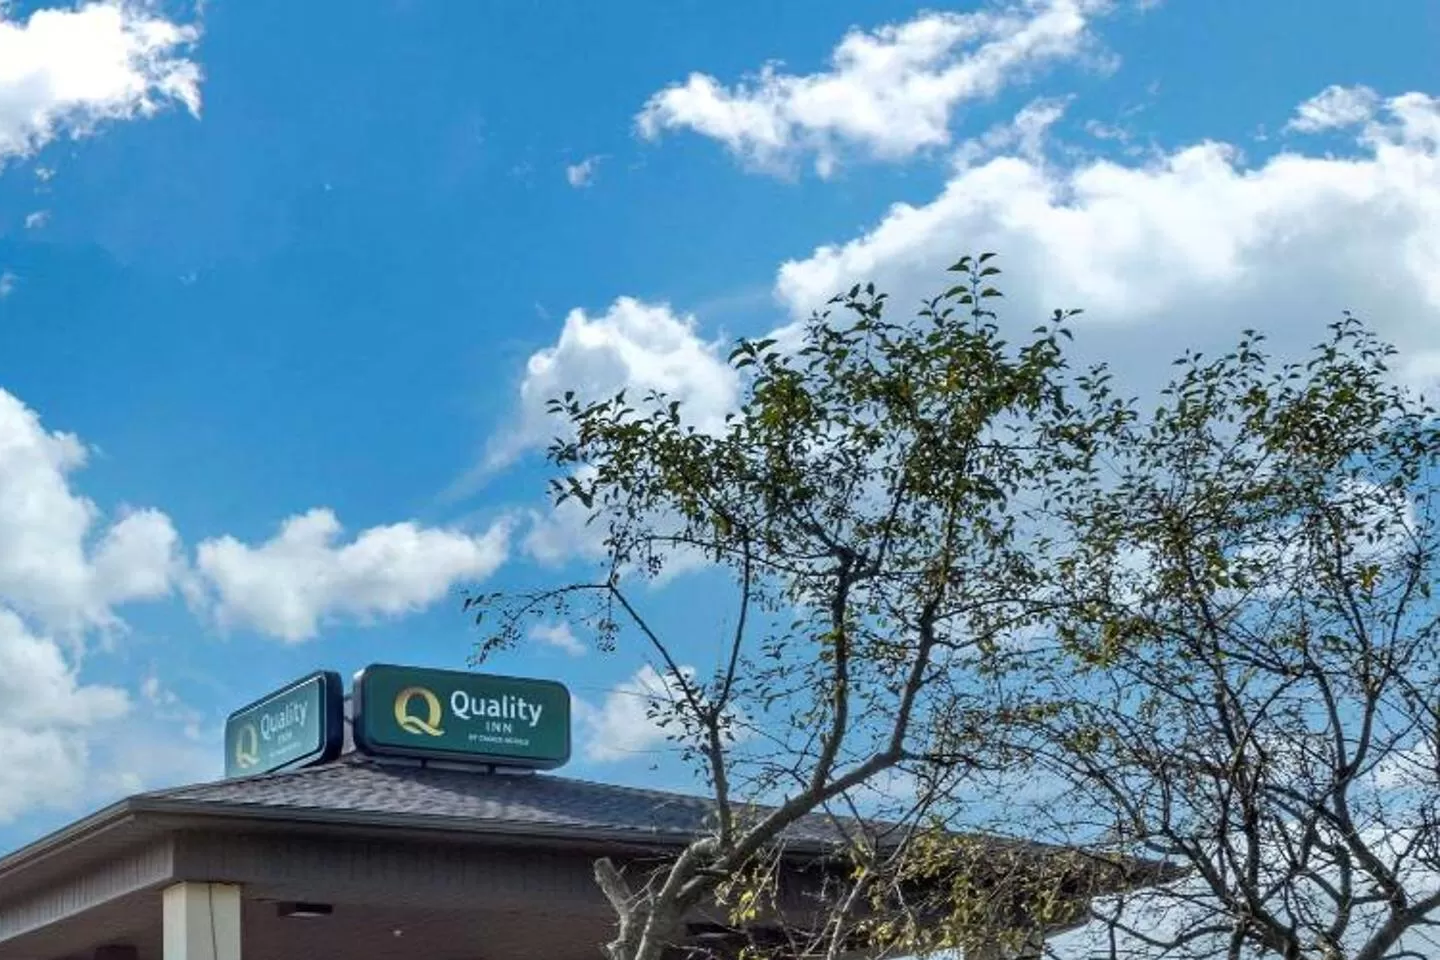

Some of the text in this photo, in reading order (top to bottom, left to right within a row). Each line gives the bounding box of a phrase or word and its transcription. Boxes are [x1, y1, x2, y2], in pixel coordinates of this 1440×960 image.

[261, 701, 308, 740] Quality
[450, 690, 542, 727] Quality
[485, 720, 513, 733] INN
